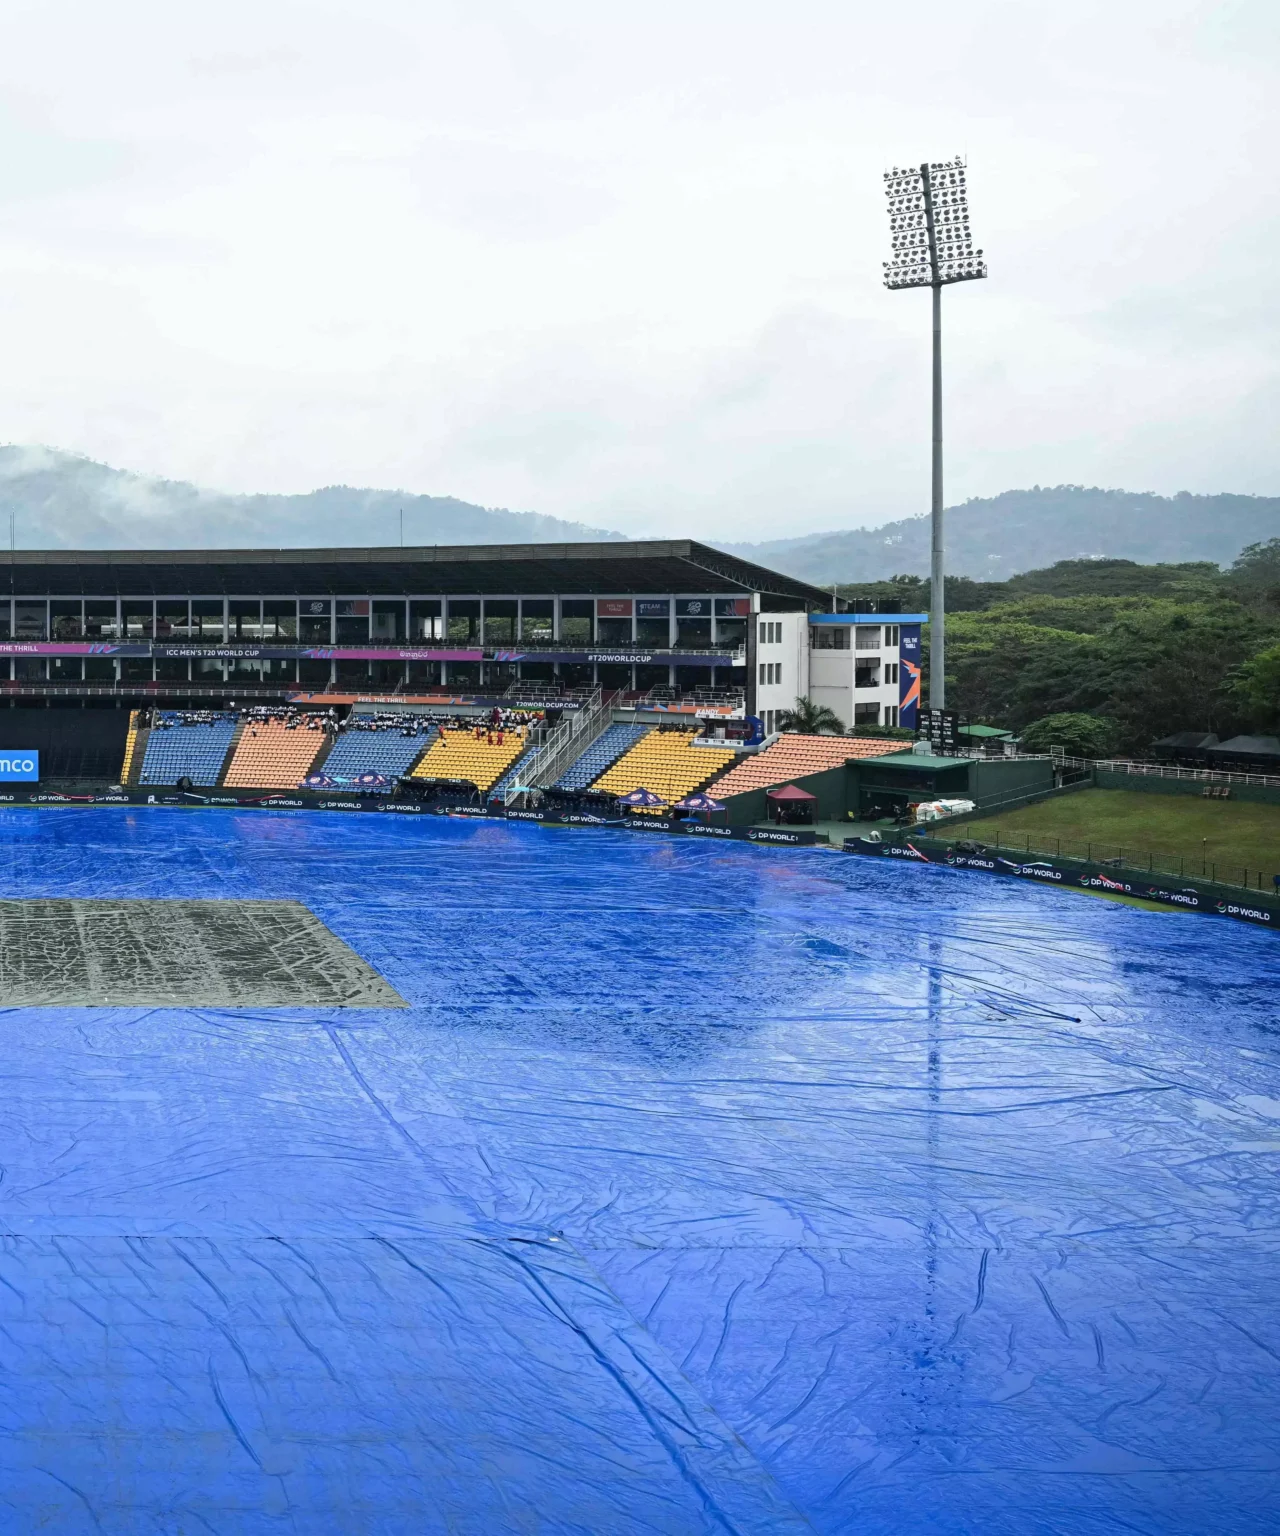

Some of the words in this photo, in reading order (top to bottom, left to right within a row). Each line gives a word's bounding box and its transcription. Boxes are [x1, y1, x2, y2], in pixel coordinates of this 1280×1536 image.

[968, 859, 994, 868] WORLD
[1034, 869, 1061, 879] WORLD
[1171, 895, 1198, 905] WORLD
[1240, 908, 1270, 921] WORLD
